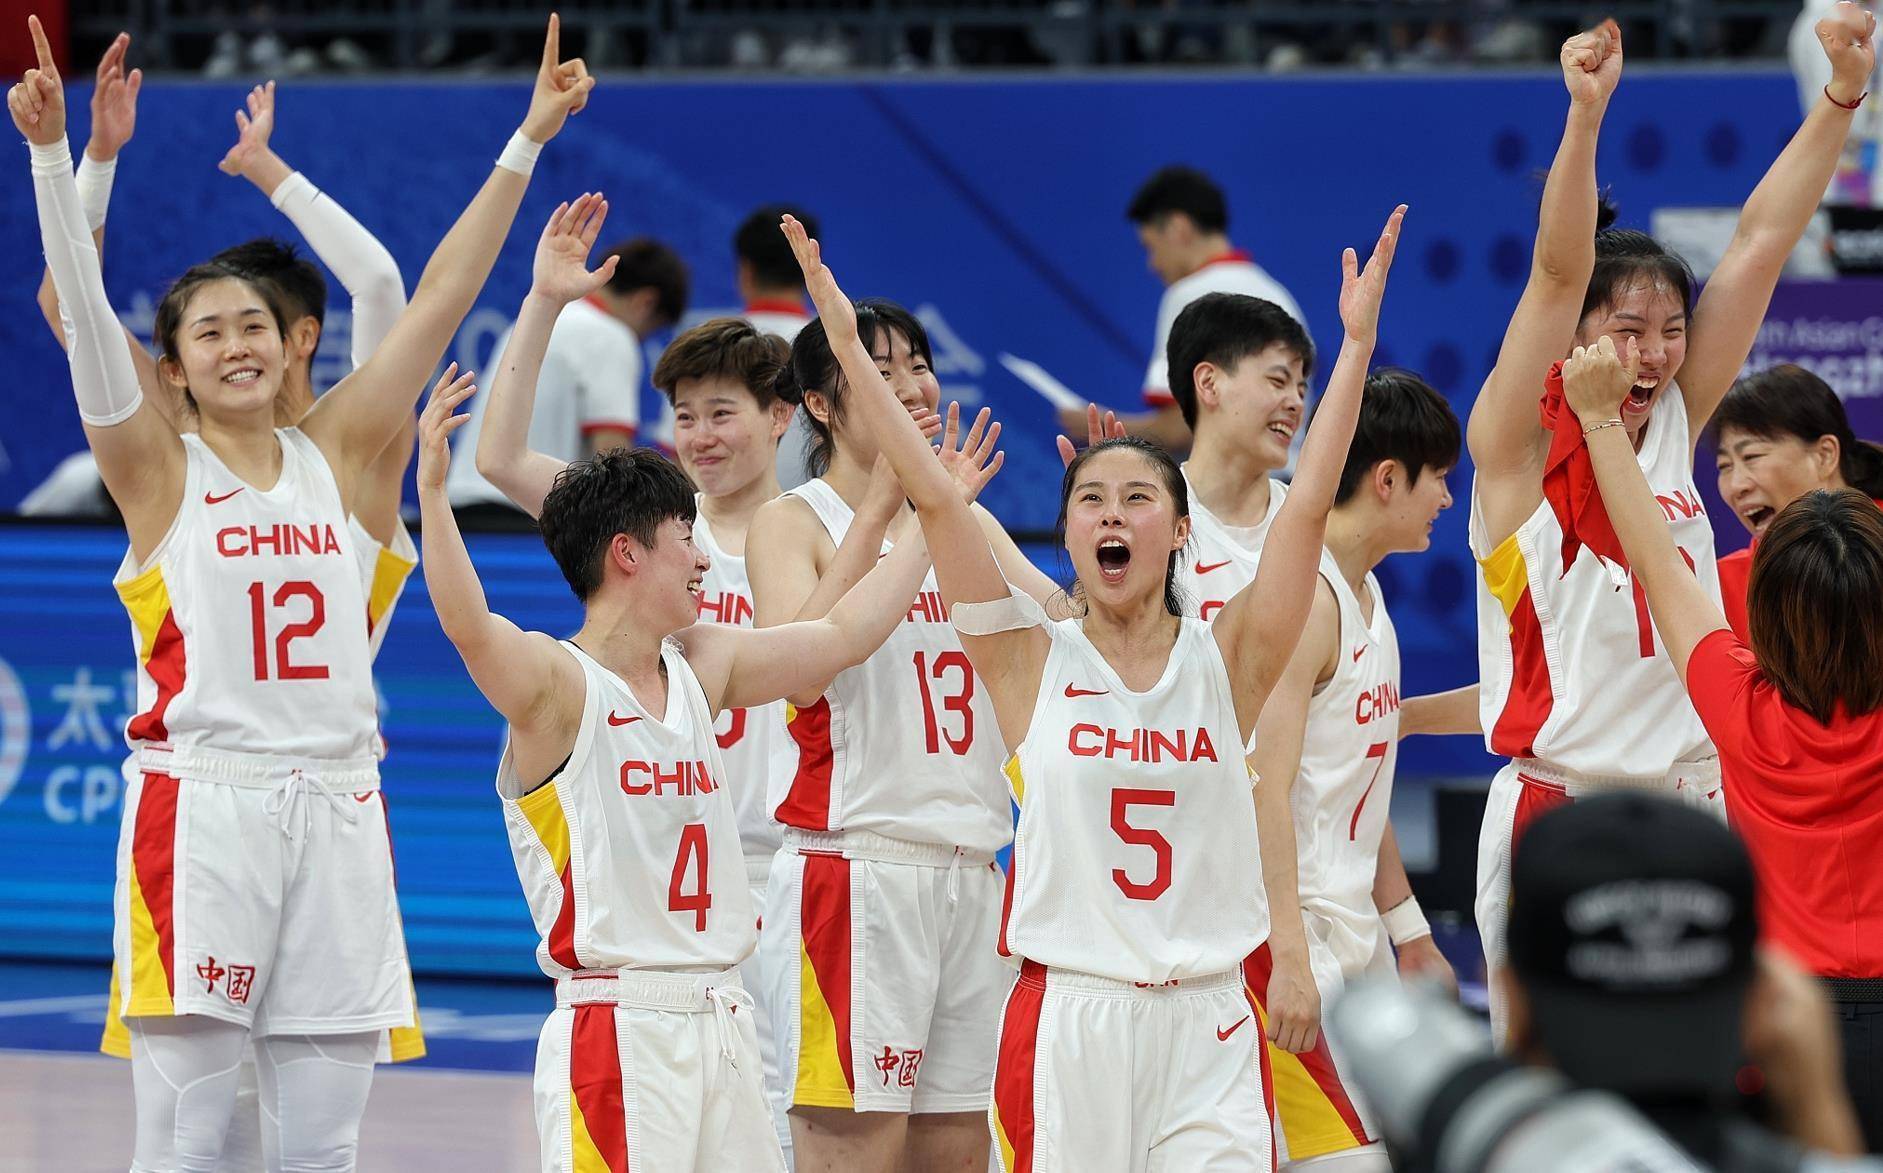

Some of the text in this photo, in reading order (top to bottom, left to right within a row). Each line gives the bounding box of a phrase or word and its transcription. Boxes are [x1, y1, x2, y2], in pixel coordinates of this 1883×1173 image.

[216, 523, 342, 558] CHINA
[247, 580, 330, 681] 12
[696, 590, 753, 625] HIN
[913, 650, 974, 755] 13
[1068, 722, 1219, 763] CHINA
[1349, 740, 1389, 841] 7
[668, 823, 712, 932] 4
[1110, 787, 1175, 901] 5
[196, 955, 256, 1005] 中国
[874, 1045, 923, 1089] 中国
